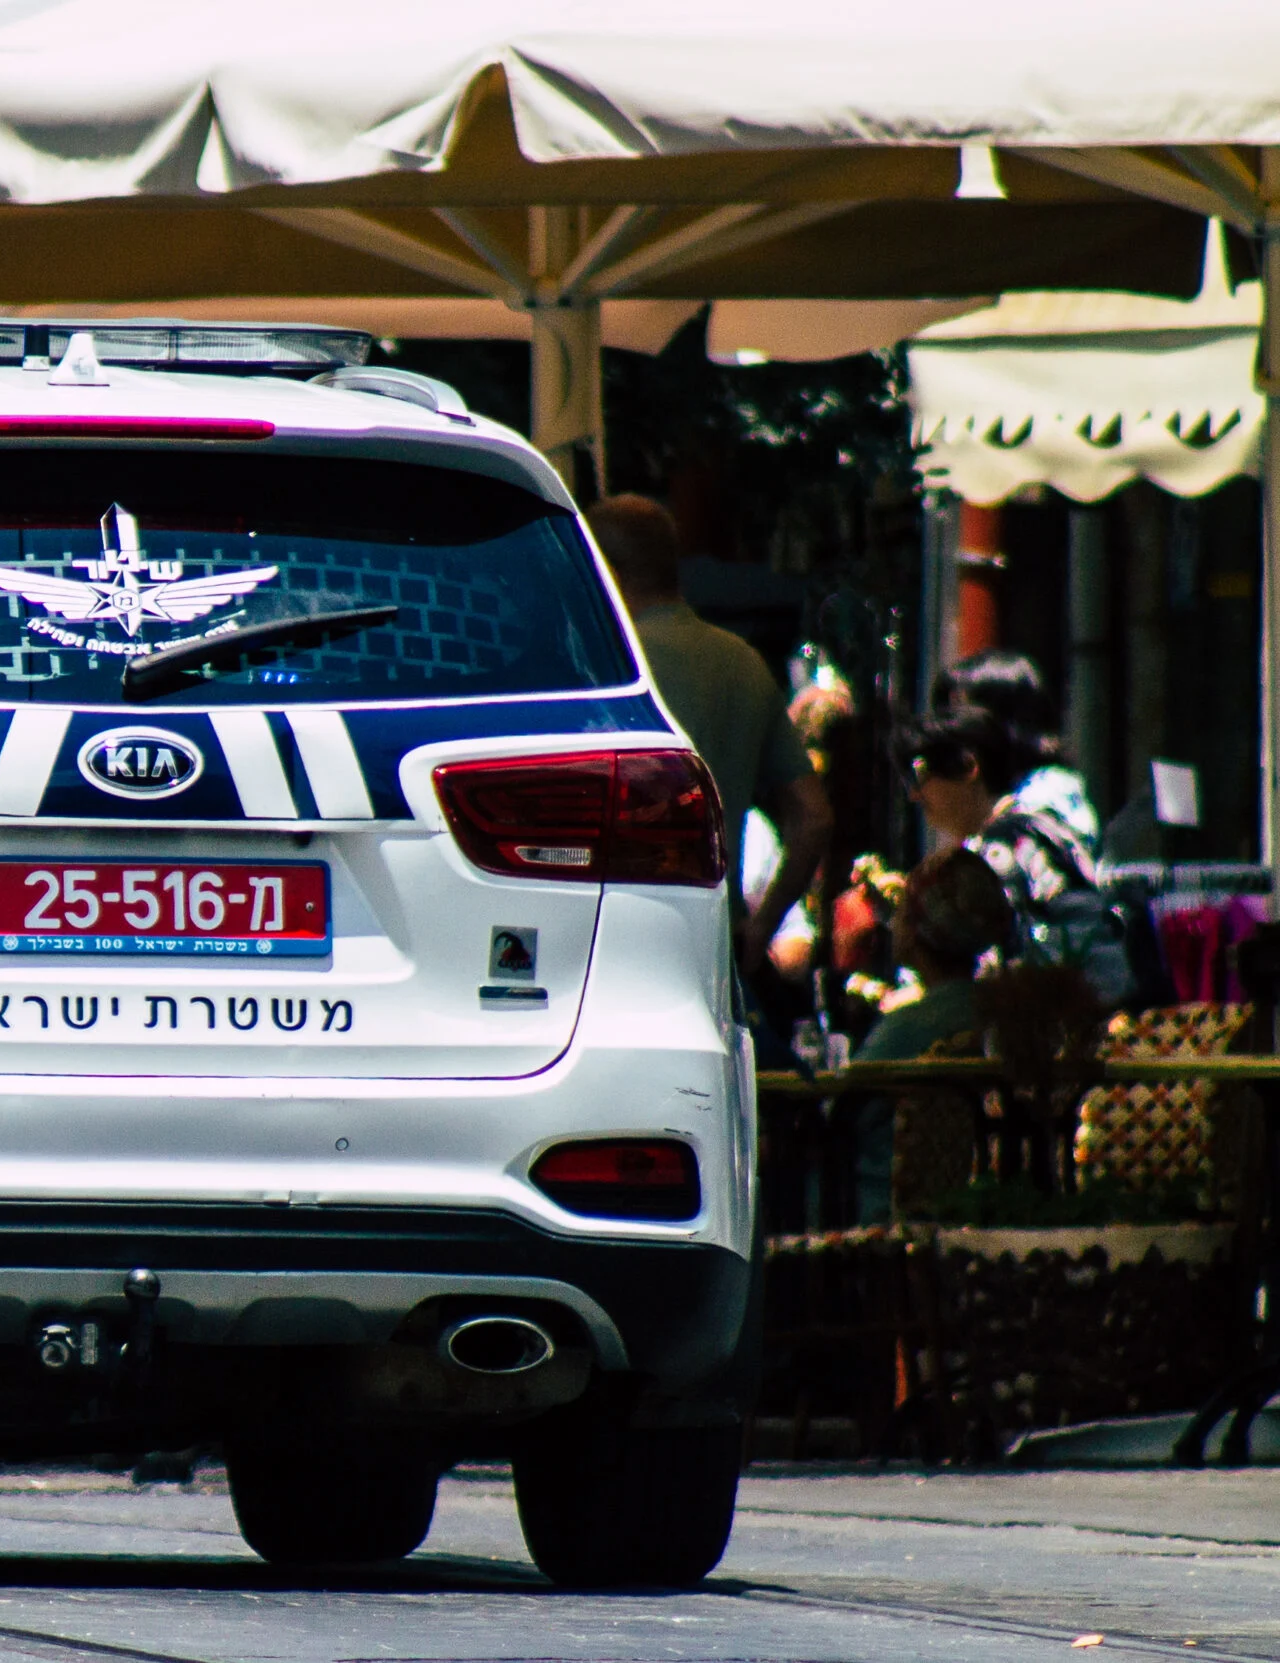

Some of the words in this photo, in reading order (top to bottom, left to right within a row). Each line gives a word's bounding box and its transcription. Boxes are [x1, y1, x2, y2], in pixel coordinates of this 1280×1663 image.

[105, 747, 178, 777] KIA
[27, 936, 84, 950] בשבילך
[95, 938, 123, 949] 100
[134, 936, 184, 950] ישראל
[194, 940, 248, 952] משטרת
[144, 996, 353, 1032] משטרת
